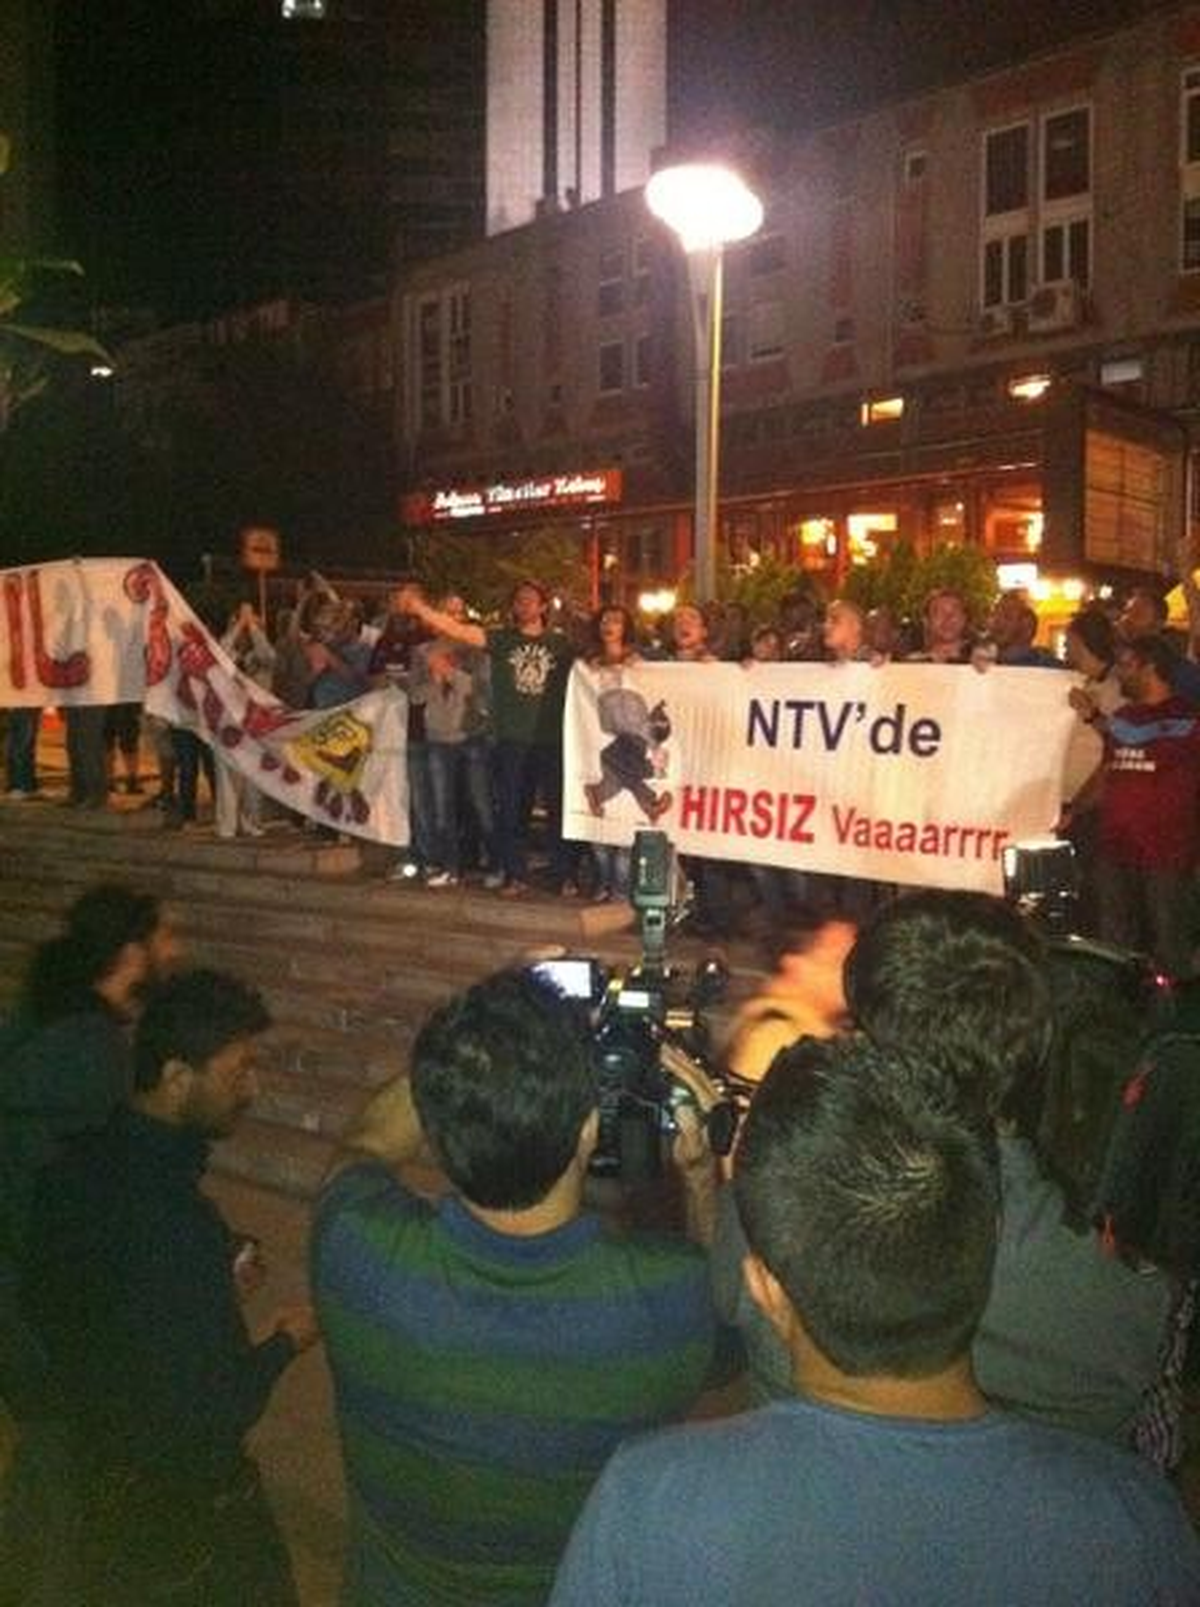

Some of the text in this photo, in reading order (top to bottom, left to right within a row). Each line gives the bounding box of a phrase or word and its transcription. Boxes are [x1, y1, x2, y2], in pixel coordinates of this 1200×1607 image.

[746, 698, 942, 757] NTV'de
[680, 785, 1010, 861] HIRSIZ Vaaaarrrr
